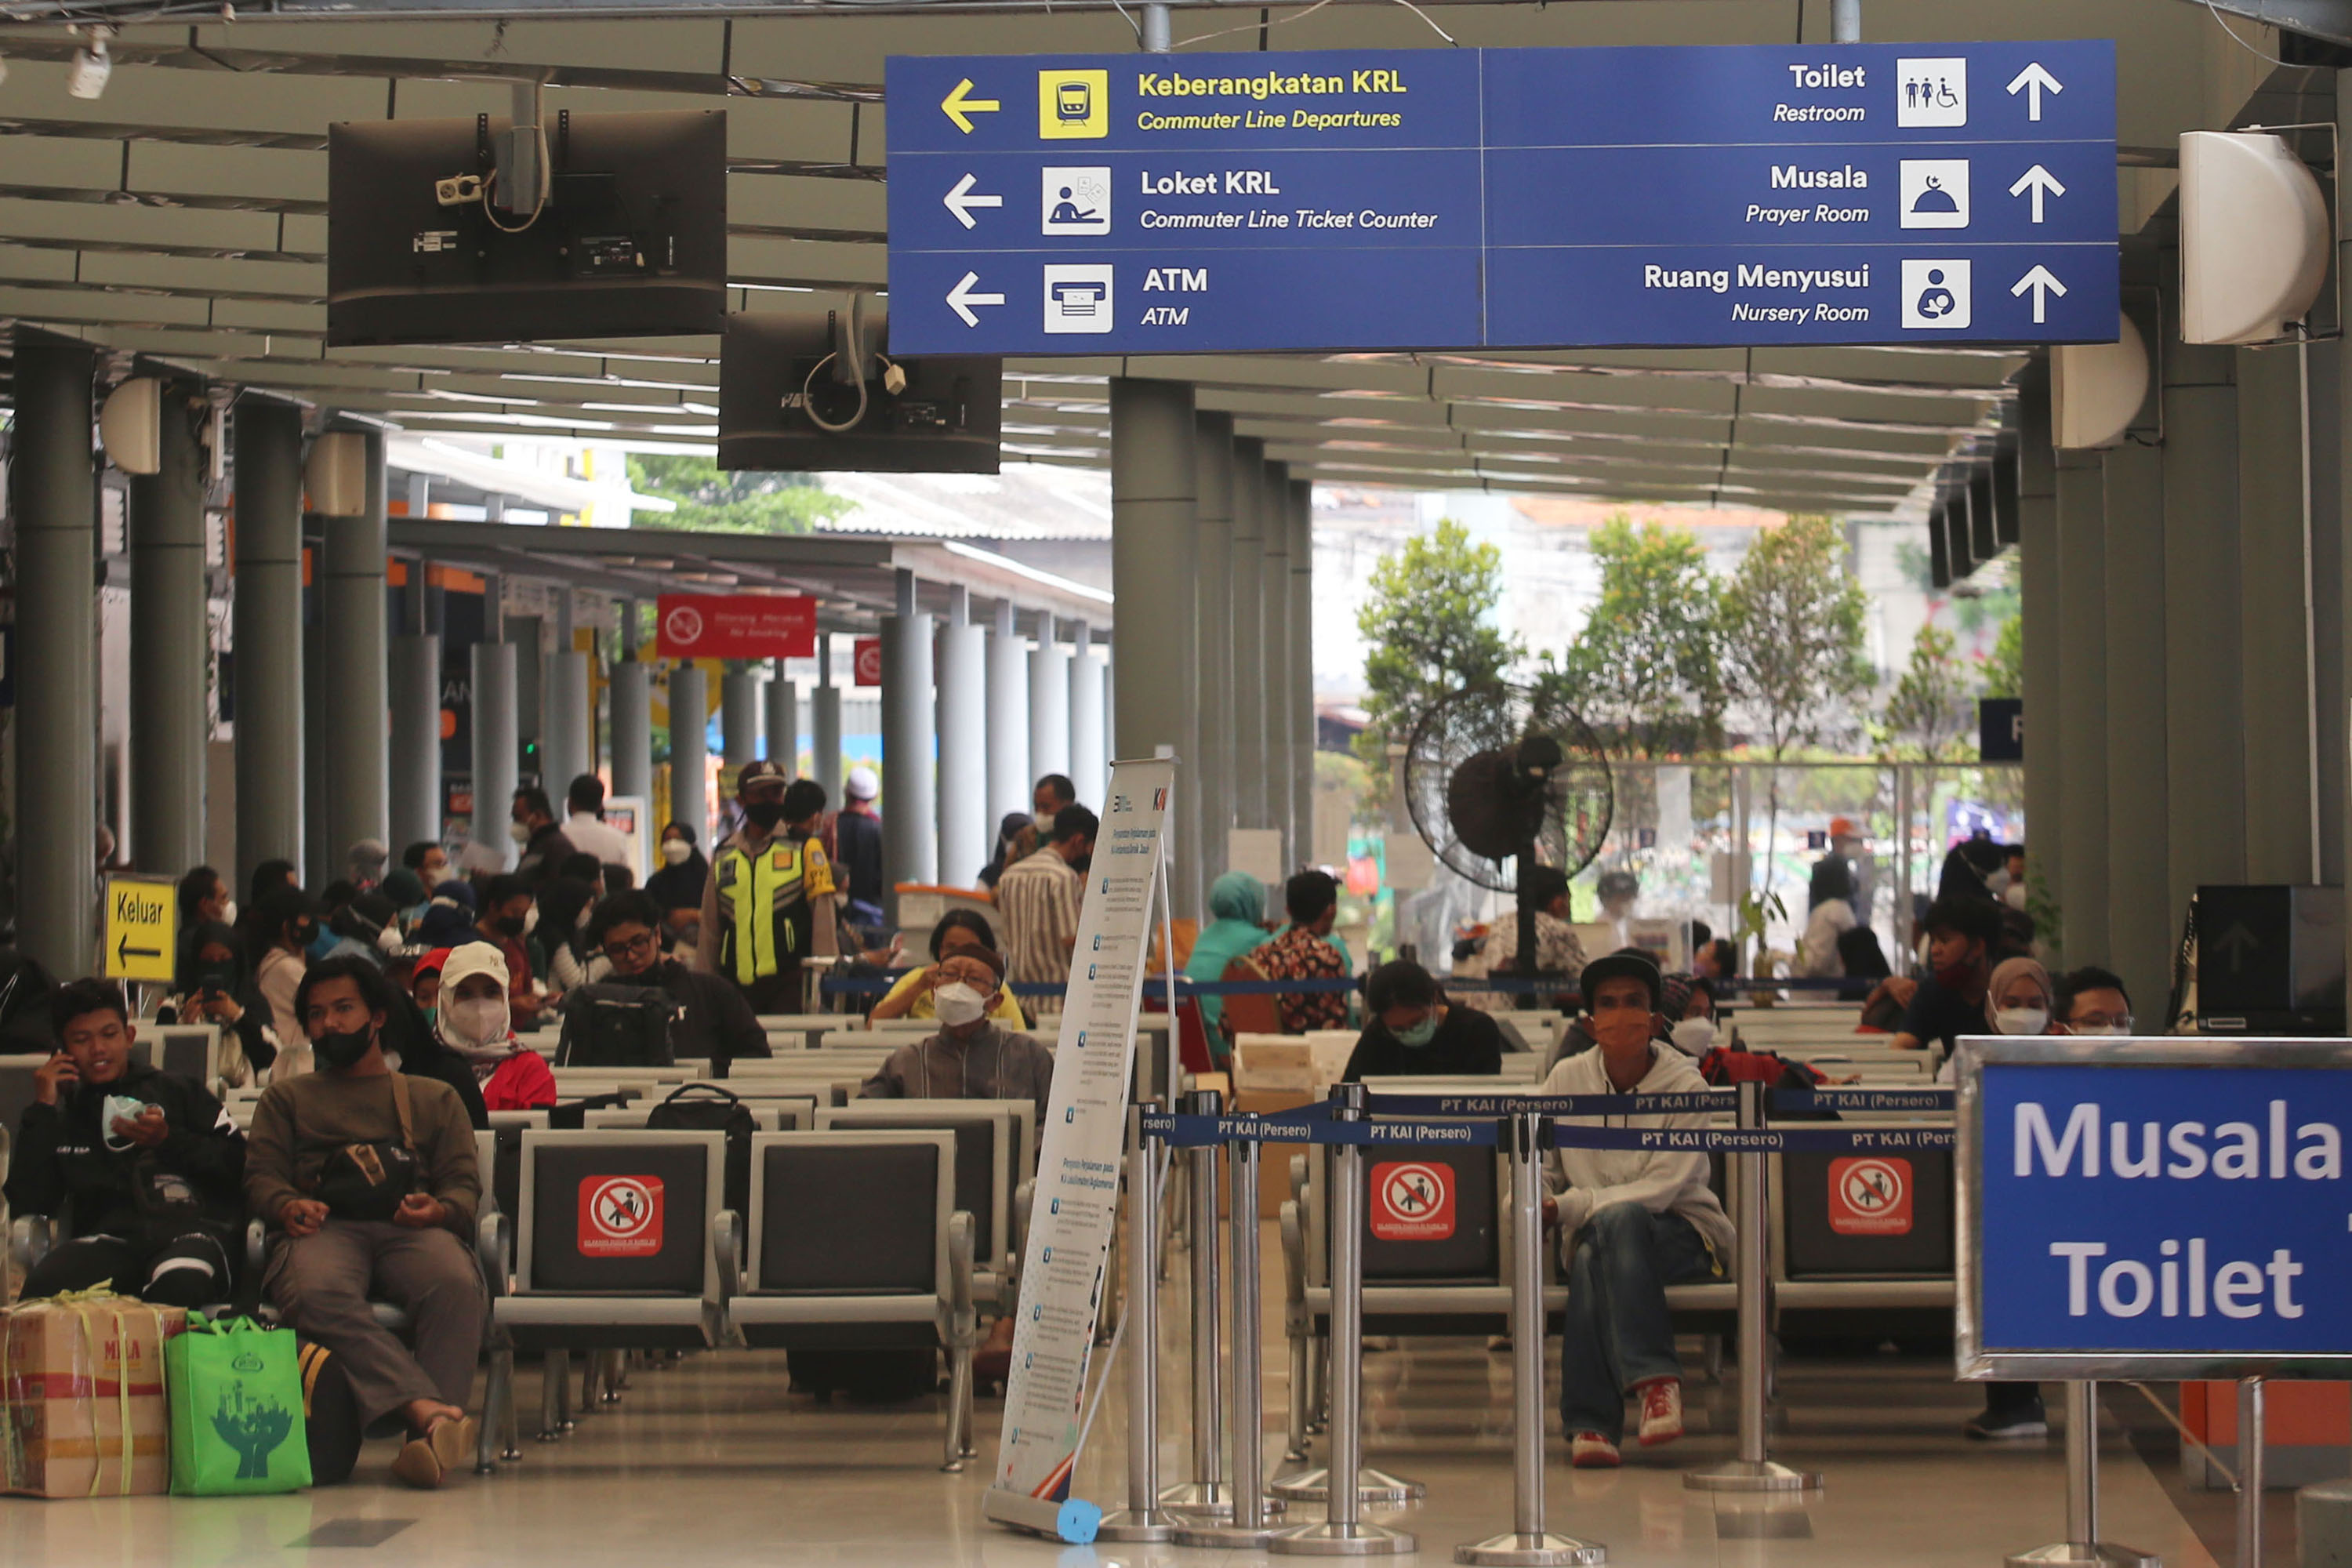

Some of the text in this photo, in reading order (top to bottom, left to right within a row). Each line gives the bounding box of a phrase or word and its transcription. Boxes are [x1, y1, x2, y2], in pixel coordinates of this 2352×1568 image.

[1138, 70, 1407, 100] Keberangkatan KRL
[1788, 64, 1866, 88] Toilet
[1138, 110, 1402, 132] Commuter Line Departures
[1773, 103, 1865, 122] Restroom
[1142, 171, 1280, 194] Loket KRL
[1771, 165, 1867, 189] Musala
[1140, 209, 1438, 229] Commuter Line Ticket Counter
[1745, 204, 1869, 227] Prayer Room
[1142, 268, 1207, 292] ATM
[1645, 263, 1869, 293] Ruang Menyusui
[1141, 307, 1189, 325] ATM
[1731, 303, 1869, 325] Nursery Room
[118, 891, 164, 925] Keluar
[1441, 1098, 1573, 1112] PT KAI (Persero)
[1635, 1096, 1656, 1110] PT
[1661, 1095, 1690, 1109] KAI
[1813, 1094, 1939, 1108] PT KAI (Persero)
[1218, 1120, 1312, 1140] PT KAI (Persero)
[1370, 1125, 1472, 1142] PT KAI (Persero)
[1642, 1132, 1784, 1149] PT KAI (Persero)
[1852, 1133, 1875, 1146] PT
[1880, 1132, 1911, 1146] KAI
[2014, 1099, 2342, 1180] Musala
[2049, 1237, 2304, 1319] Toilet
